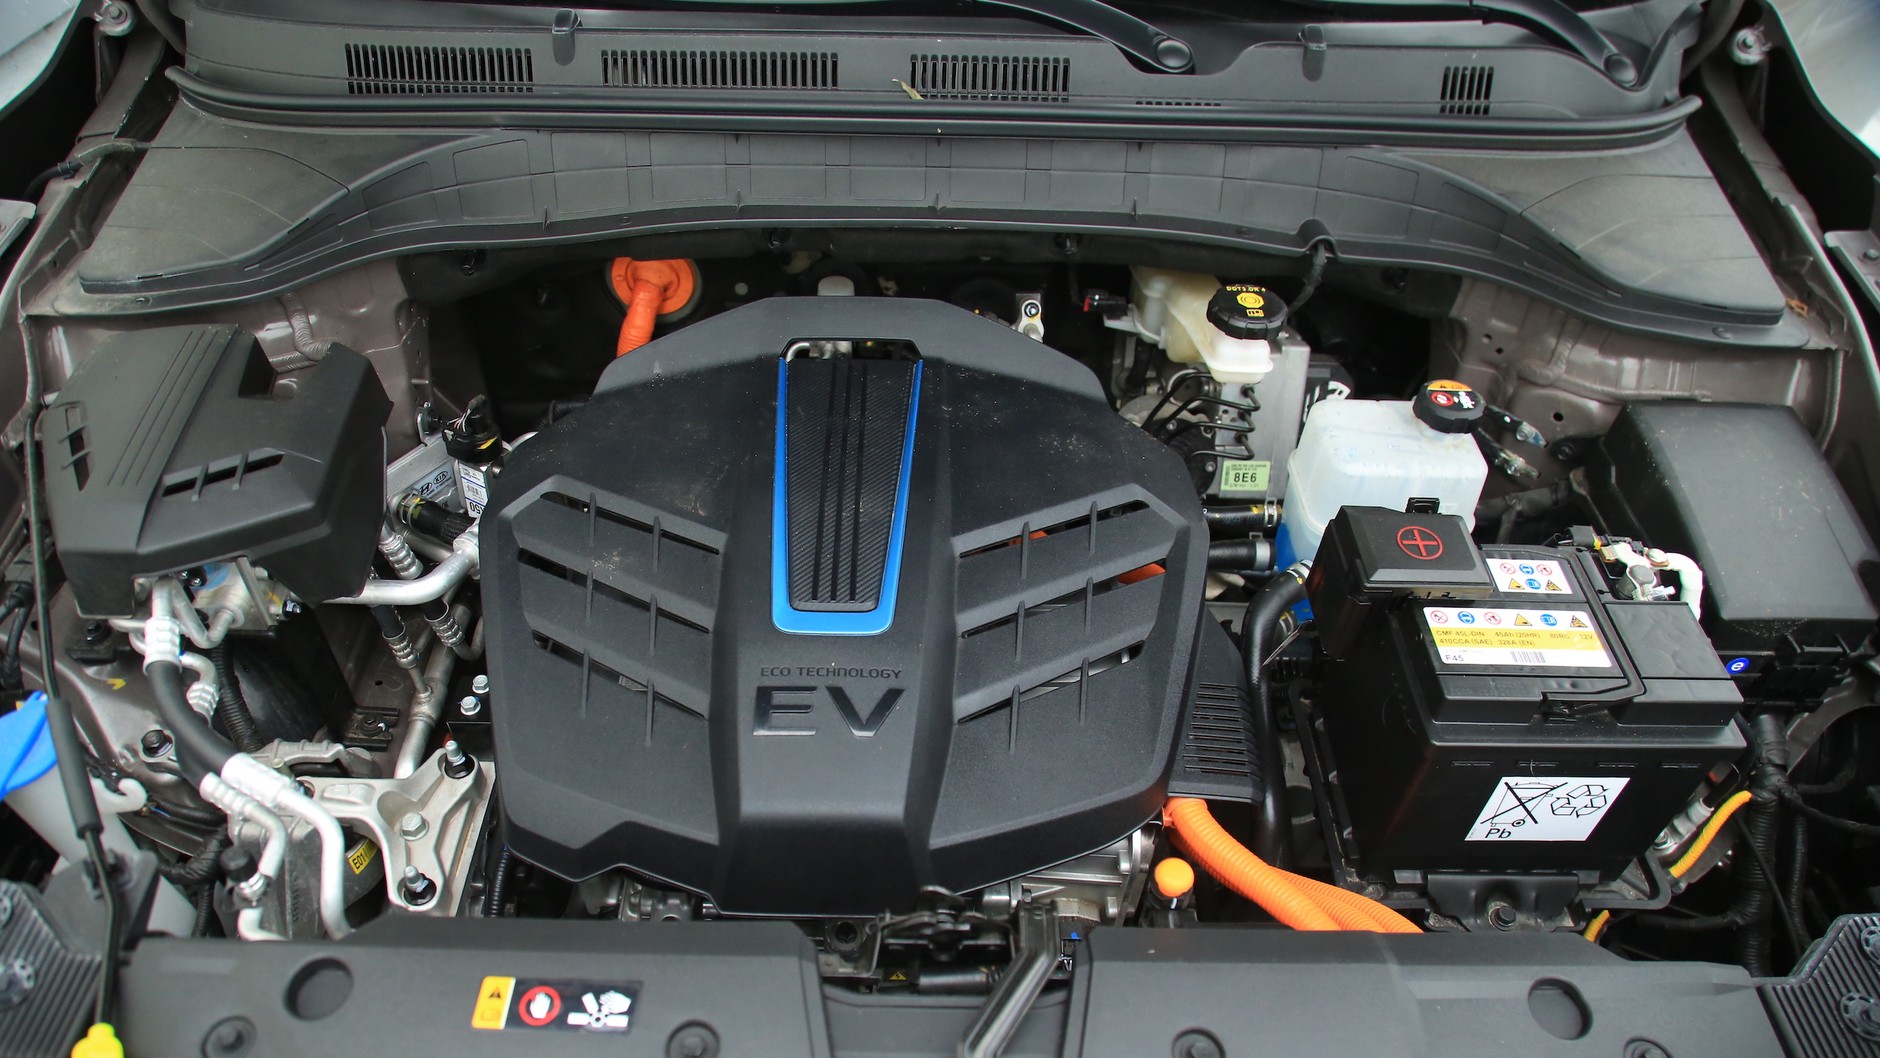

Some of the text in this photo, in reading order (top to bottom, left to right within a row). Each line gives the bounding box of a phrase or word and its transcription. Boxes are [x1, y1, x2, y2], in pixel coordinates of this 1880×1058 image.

[434, 472, 447, 483] KIA
[1233, 472, 1257, 483] 8E6
[1471, 638, 1493, 646] (SAE)
[1519, 639, 1535, 647] (EN)
[1445, 654, 1464, 662] F45
[760, 666, 902, 679] ECO TECHNOLOGY
[753, 685, 905, 739] EV
[1484, 827, 1512, 839] Pb
[352, 852, 366, 870] E01
